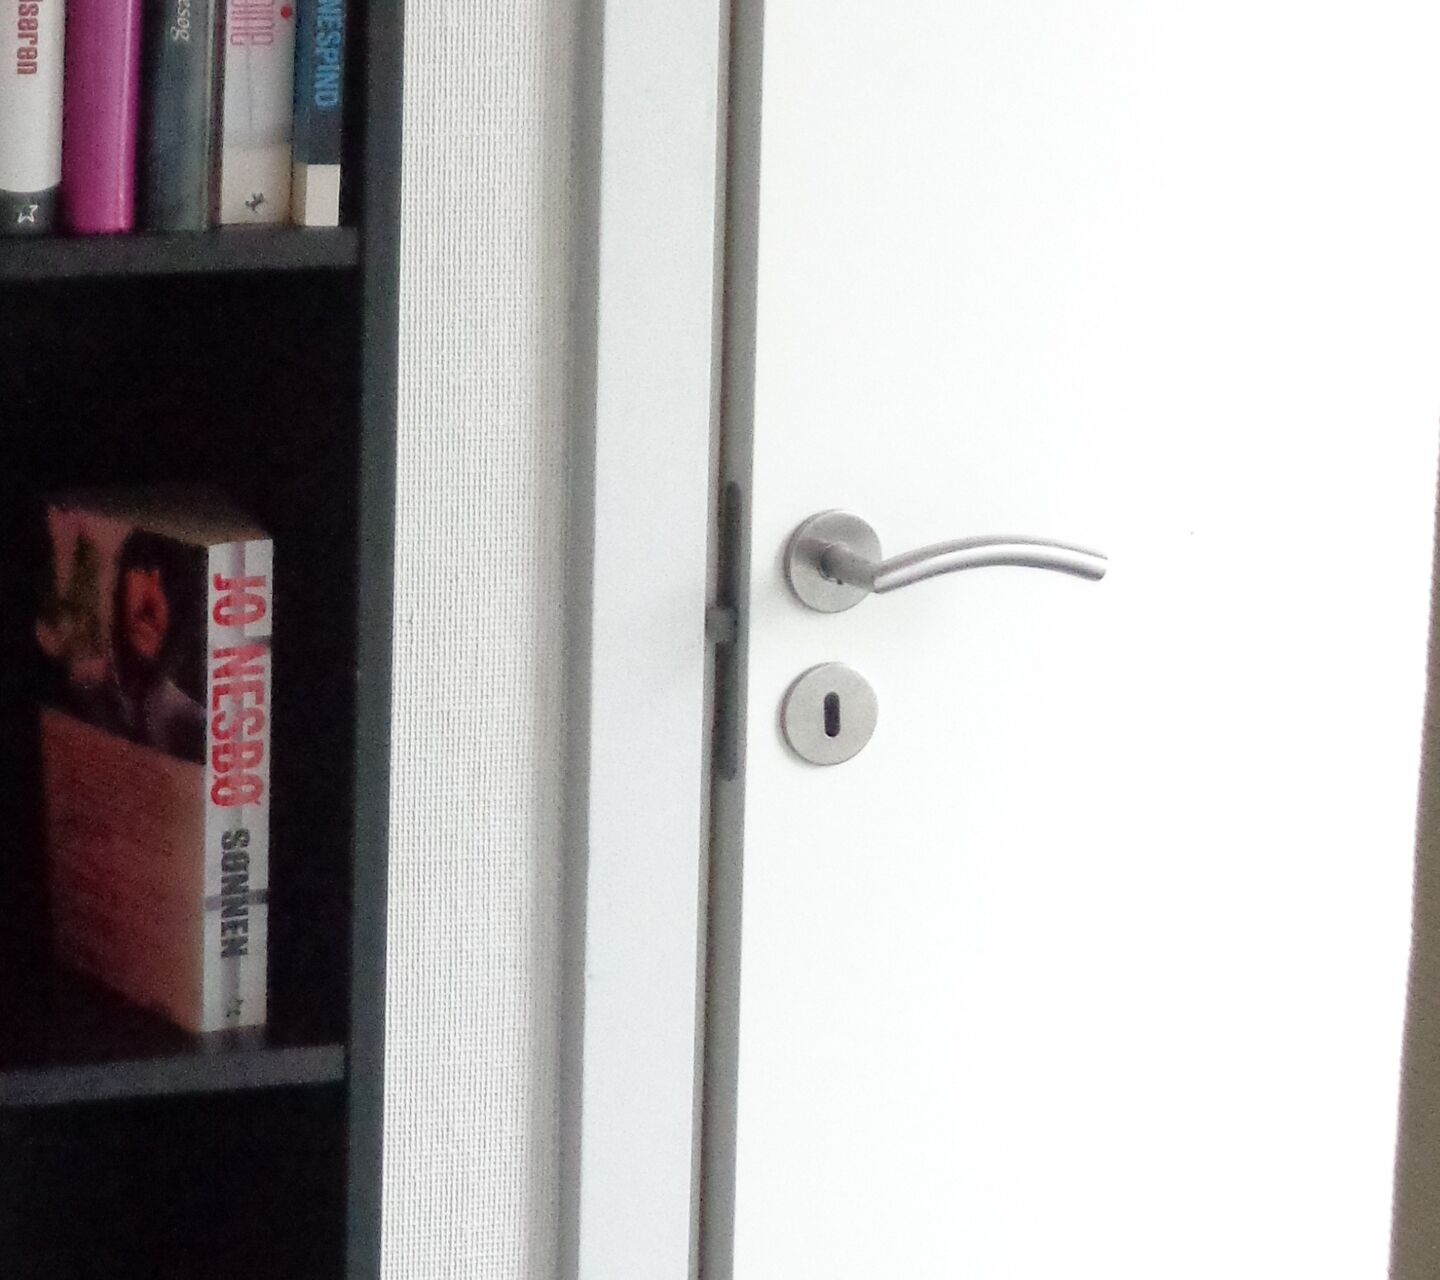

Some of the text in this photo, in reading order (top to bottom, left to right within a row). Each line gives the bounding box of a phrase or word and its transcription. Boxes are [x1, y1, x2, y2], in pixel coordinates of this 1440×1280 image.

[210, 572, 269, 808] JO NESBØ
[219, 828, 251, 960] SØNNEN
